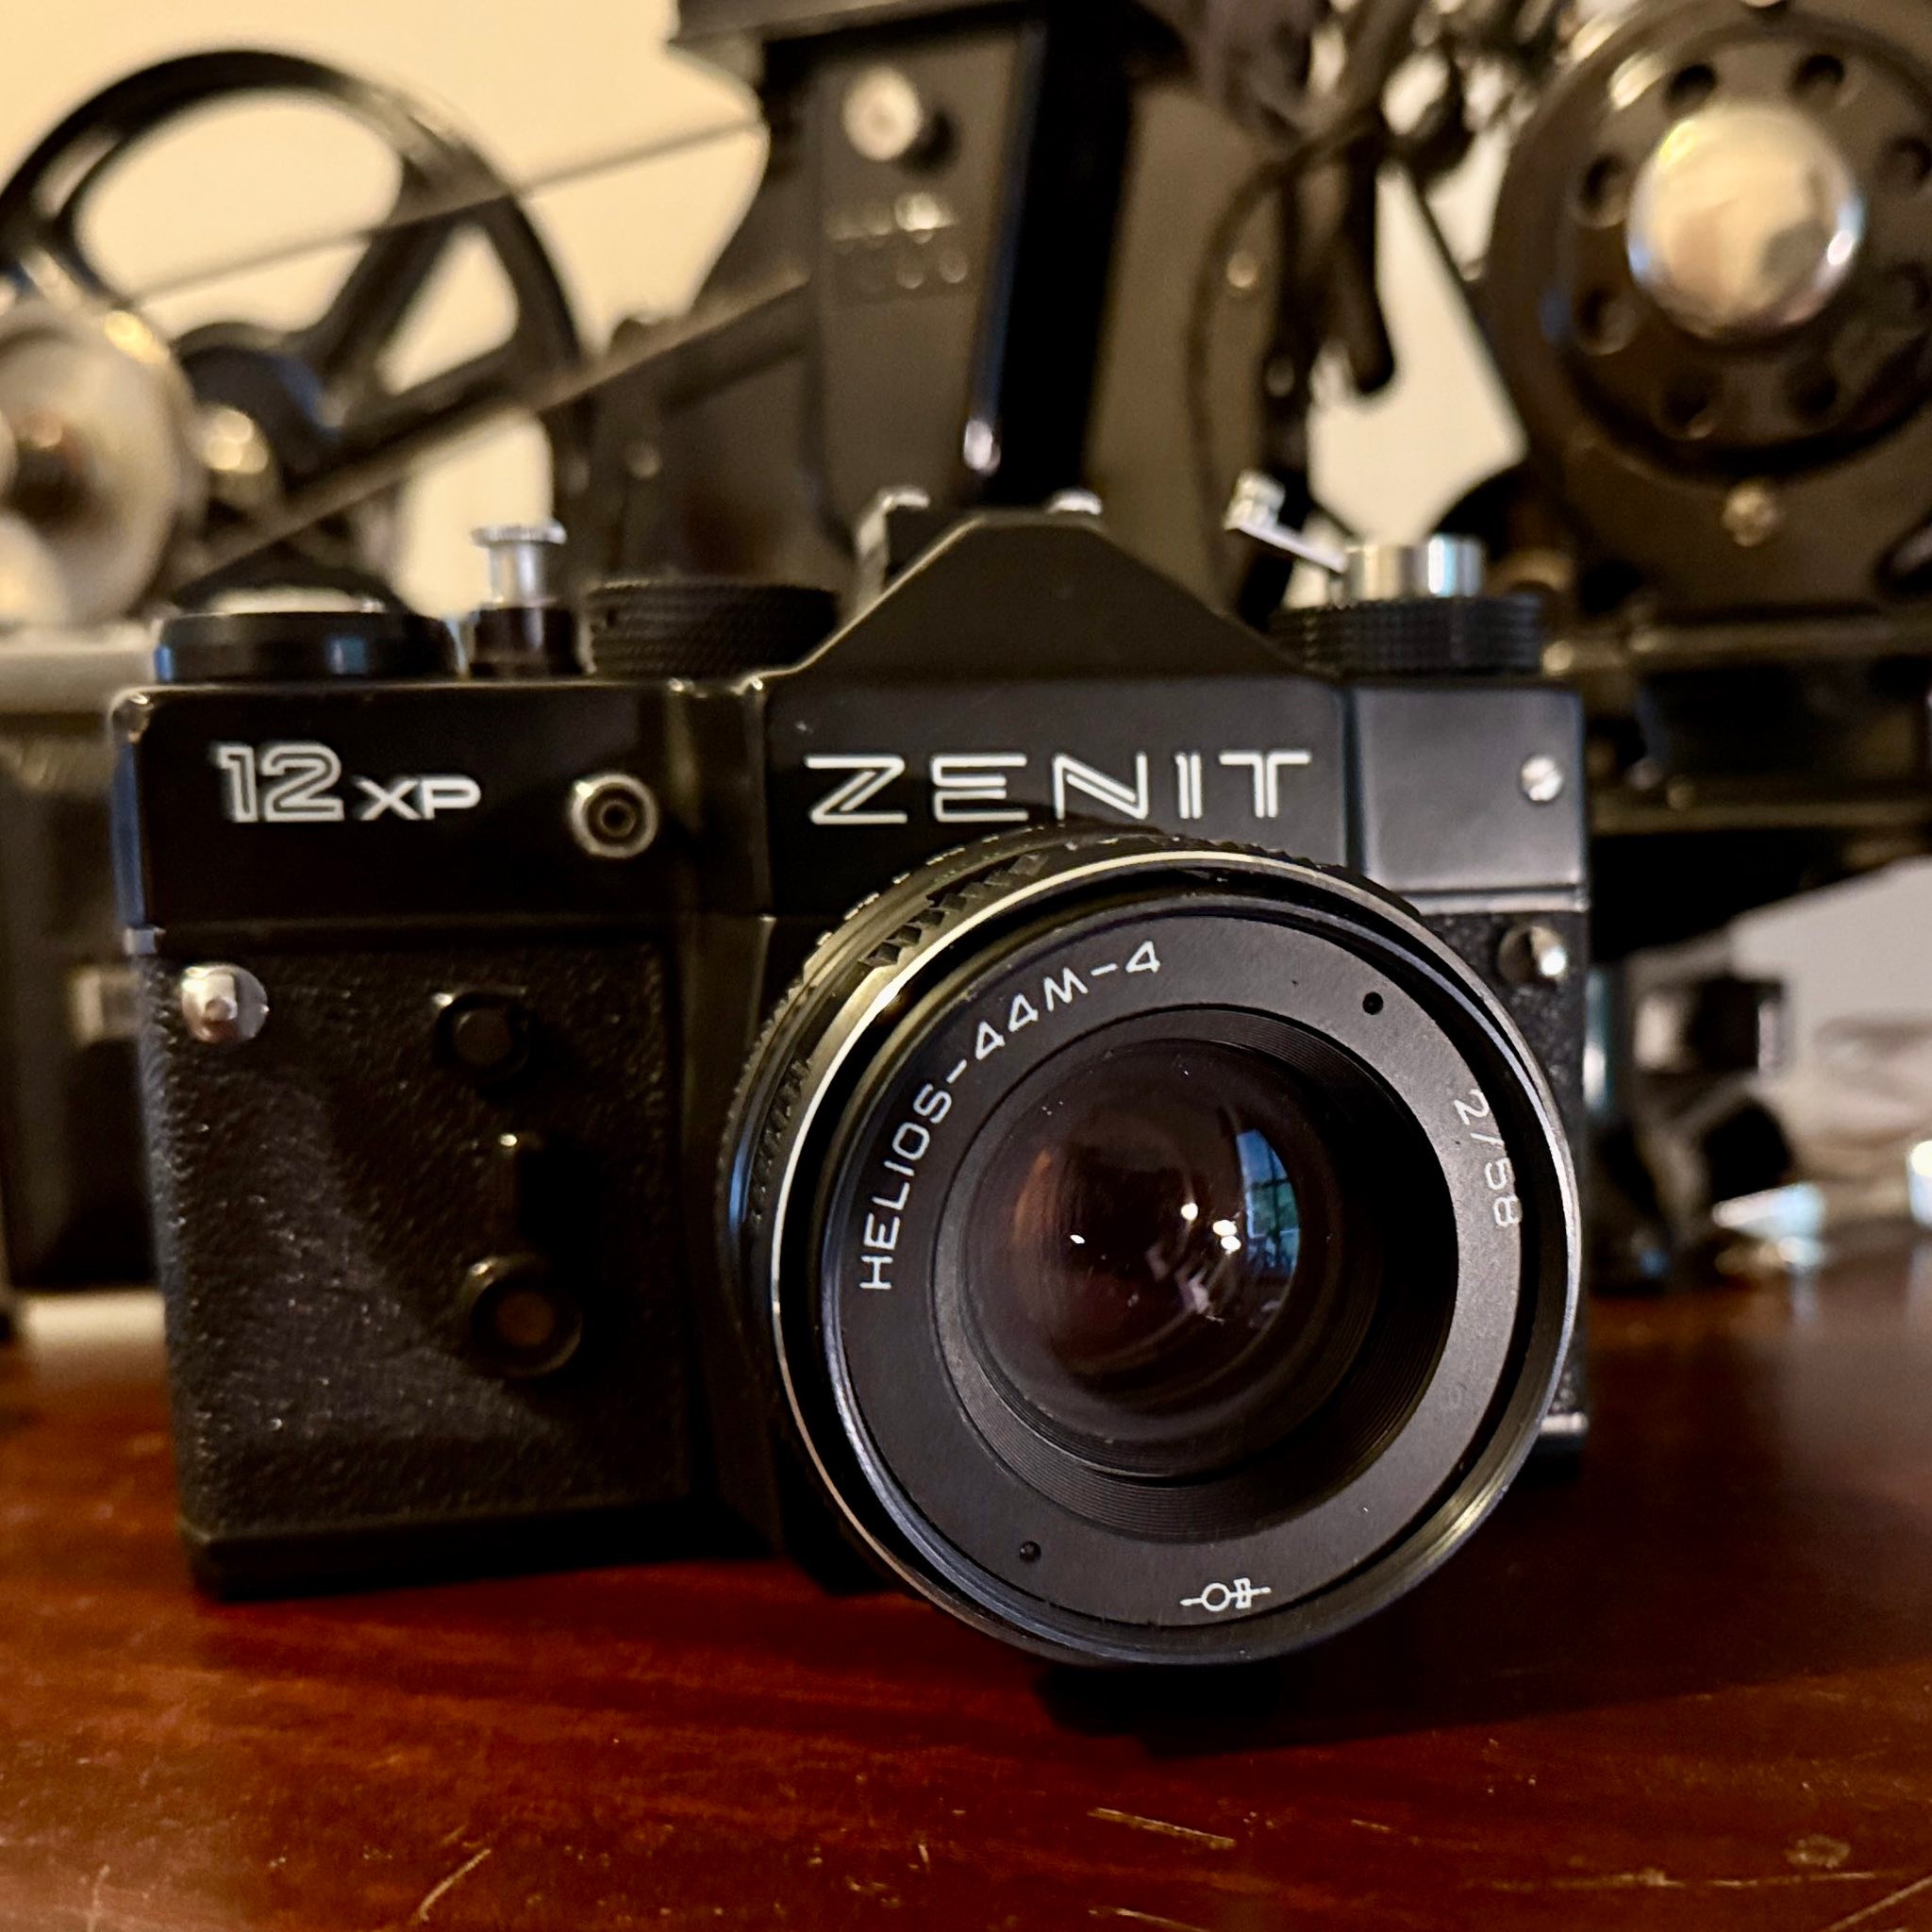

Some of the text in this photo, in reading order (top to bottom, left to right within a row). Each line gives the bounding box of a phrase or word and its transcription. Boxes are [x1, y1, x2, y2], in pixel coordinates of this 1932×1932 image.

[213, 741, 345, 824] 12
[803, 749, 1312, 824] ZENIT
[1453, 1088, 1523, 1228] 2/58
